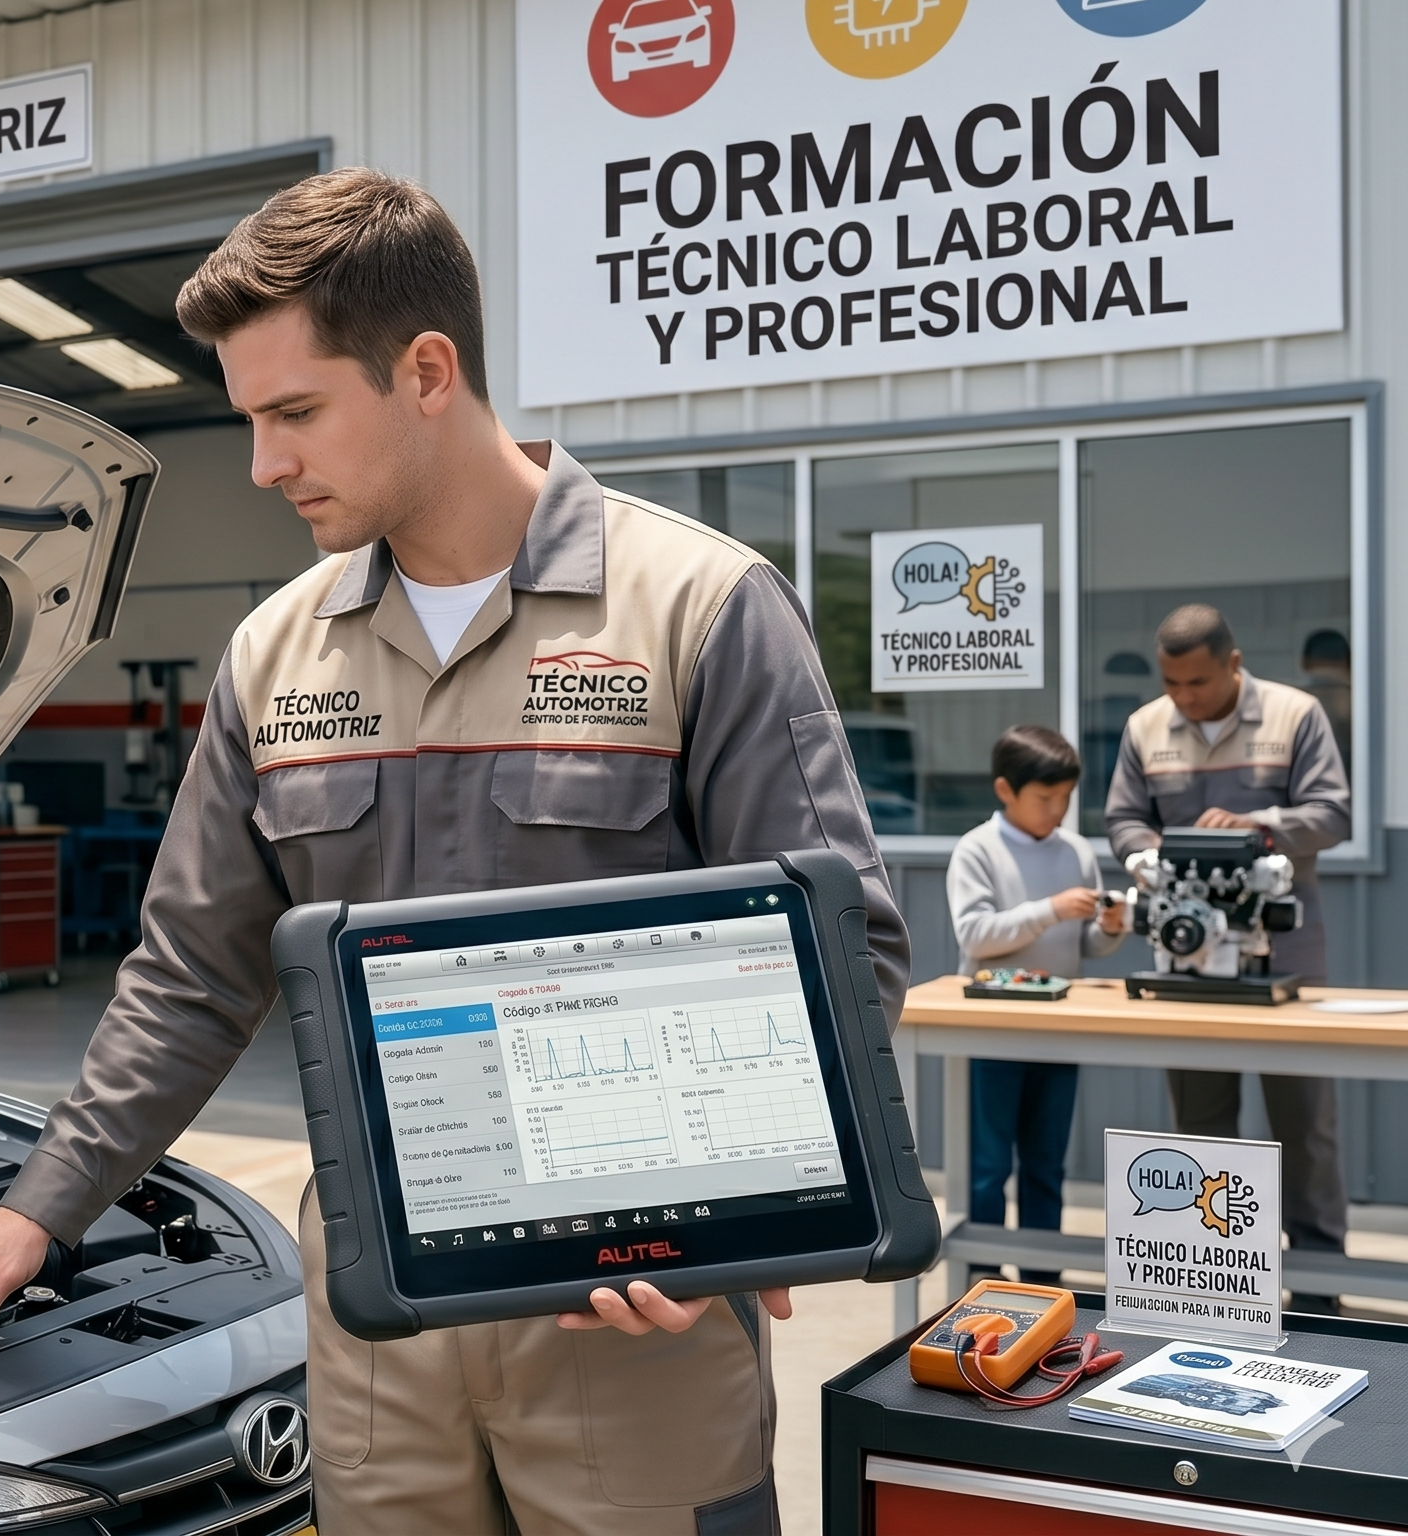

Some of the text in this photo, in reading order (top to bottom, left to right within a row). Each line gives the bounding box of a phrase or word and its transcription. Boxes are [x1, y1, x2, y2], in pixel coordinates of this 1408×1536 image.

[603, 61, 1222, 239] FORMACIÓN
[596, 176, 1234, 304] TÉCNICO LABORAL
[645, 256, 1189, 366] Y PROFESIONAL
[903, 562, 959, 584] HOLA!
[880, 629, 1035, 651] TÉCNICO LABORAL
[891, 652, 1023, 673] Y PROFESIONAL
[526, 667, 648, 694] TÉCNICO
[273, 689, 360, 717] TÉCNICO
[522, 696, 649, 713] AUTOMOTRIZ
[253, 713, 382, 749] AUTOMOTRIZ
[521, 714, 563, 724] CENTRO
[565, 714, 580, 724] DE
[361, 935, 414, 949] AUTEL
[1138, 1166, 1194, 1193] HOLA!
[597, 1241, 682, 1265] AUTEL
[1115, 1233, 1272, 1272] TÉCNICO LABORAL
[1126, 1261, 1261, 1296] Y PROFESIONAL
[1182, 1301, 1211, 1318] PARA
[1228, 1307, 1272, 1325] FUTURO
